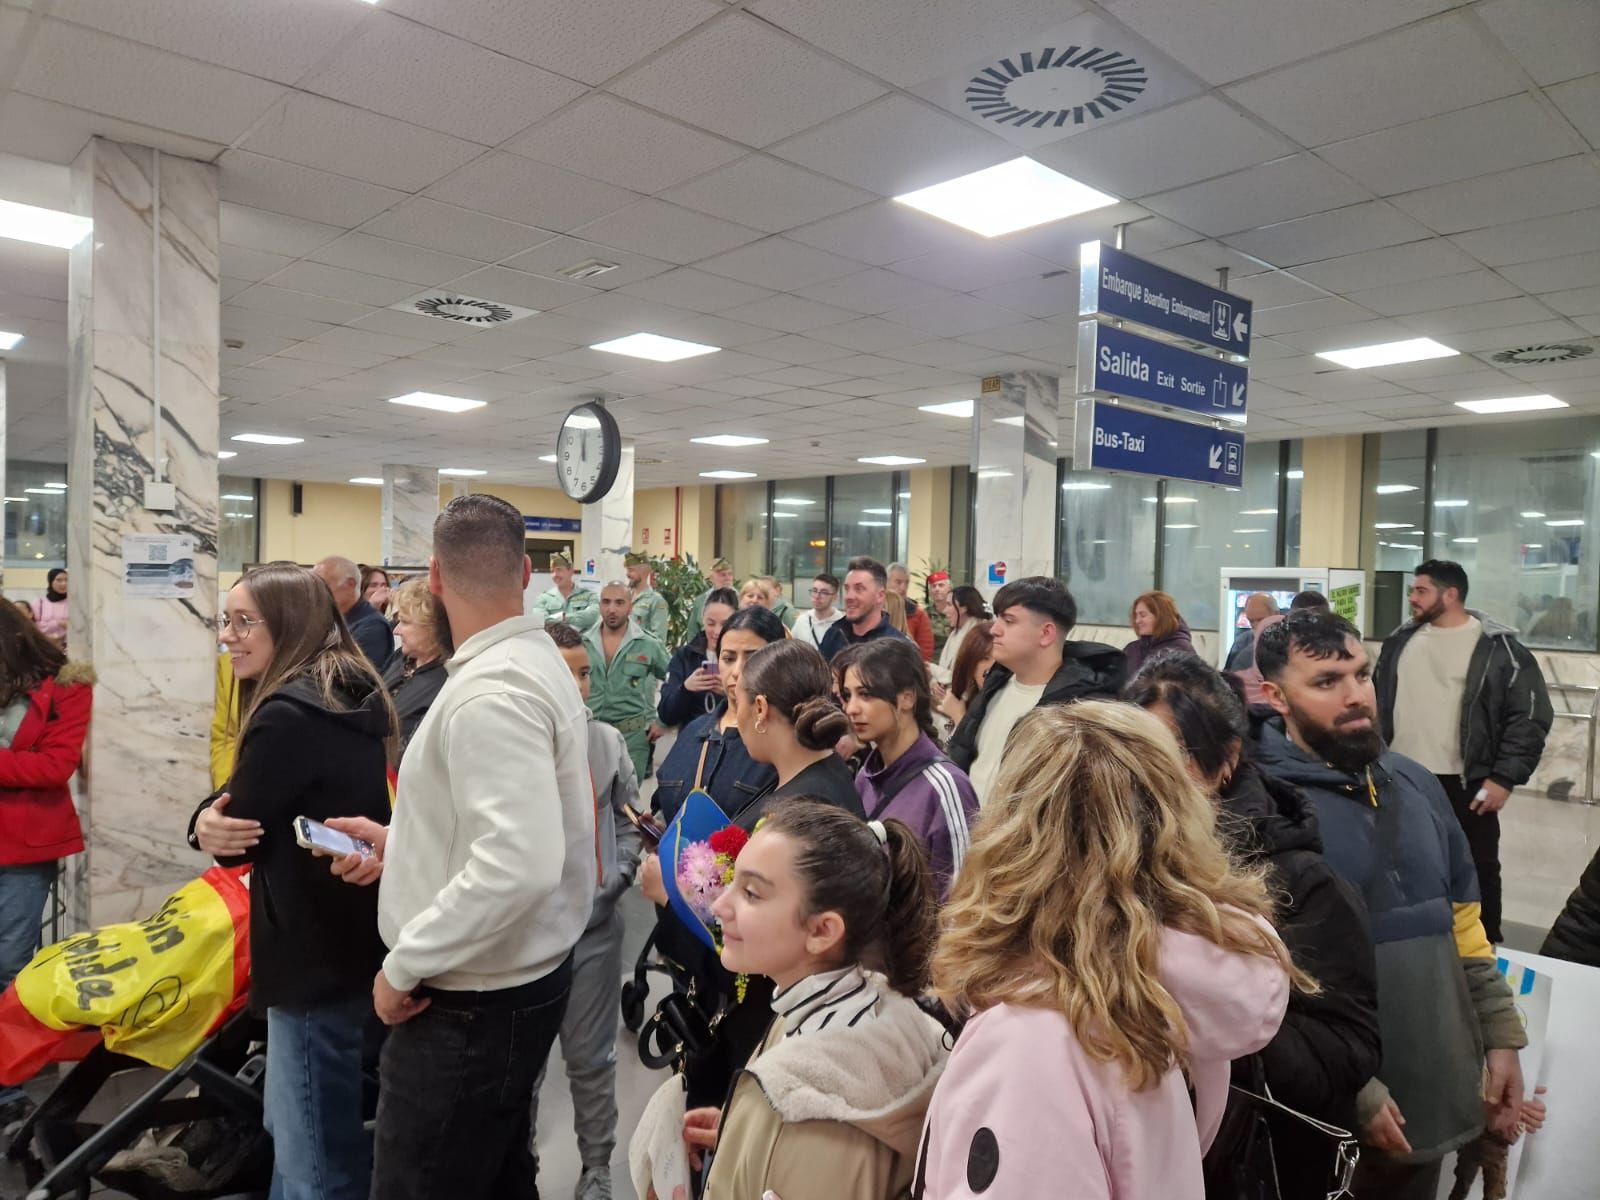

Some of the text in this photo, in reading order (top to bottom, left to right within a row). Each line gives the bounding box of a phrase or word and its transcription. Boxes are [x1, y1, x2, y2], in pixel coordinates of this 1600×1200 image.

[1103, 266, 1212, 325] Embarque Boarding Embarquement
[1099, 346, 1206, 396] Salida Exit Sortie
[1095, 427, 1145, 453] Bus-Taxi
